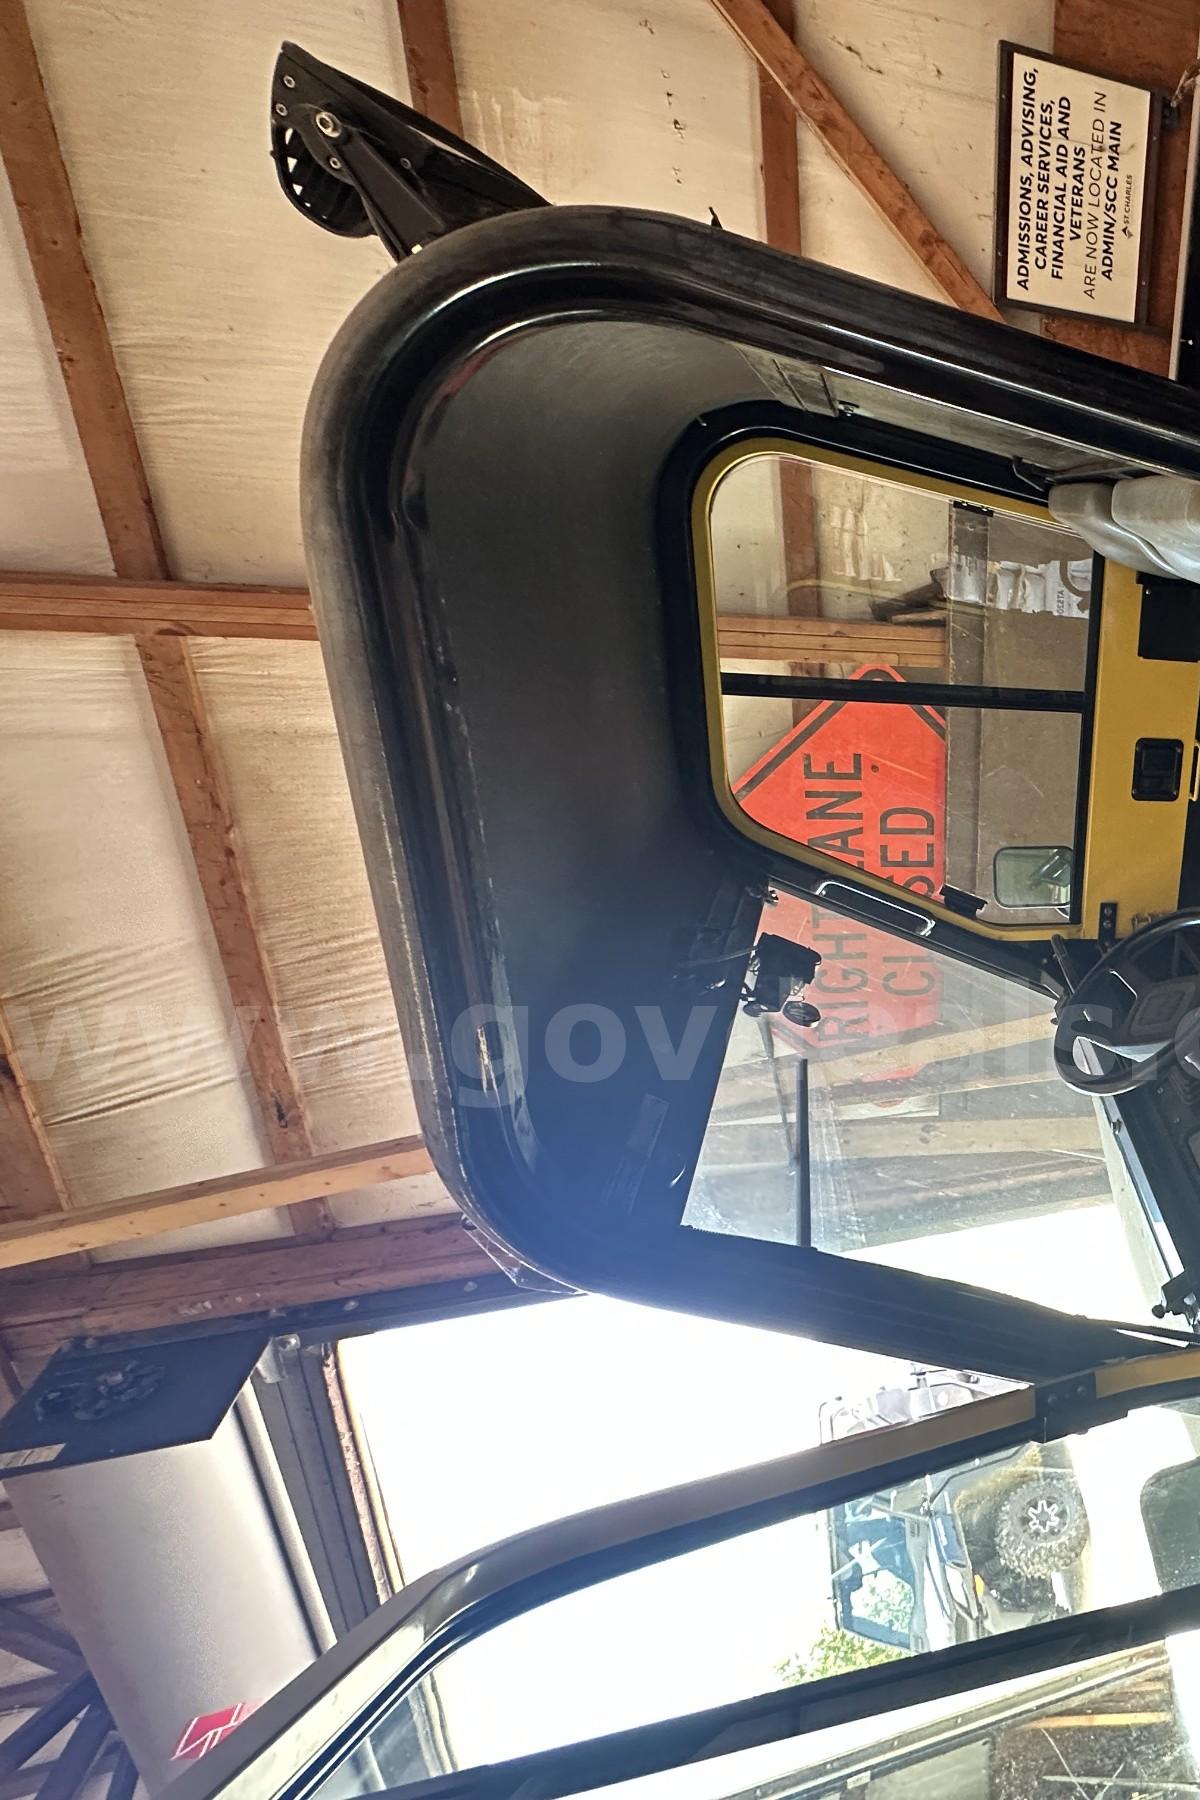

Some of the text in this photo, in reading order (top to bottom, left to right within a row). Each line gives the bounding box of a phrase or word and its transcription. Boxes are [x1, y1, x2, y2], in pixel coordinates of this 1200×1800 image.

[1017, 68, 1039, 290] ADMISSIONS, ADVISING,
[1035, 99, 1055, 270] CAREER SERVICES,
[1051, 96, 1071, 280] FINANCIAL AID AND
[1069, 146, 1086, 242] VETERANS
[1083, 91, 1107, 299] ARE NOW LOCATED IN
[1100, 121, 1122, 281] ADMIN/SCC MAIN
[1124, 174, 1133, 213] CHARLES
[803, 752, 865, 870] ANE
